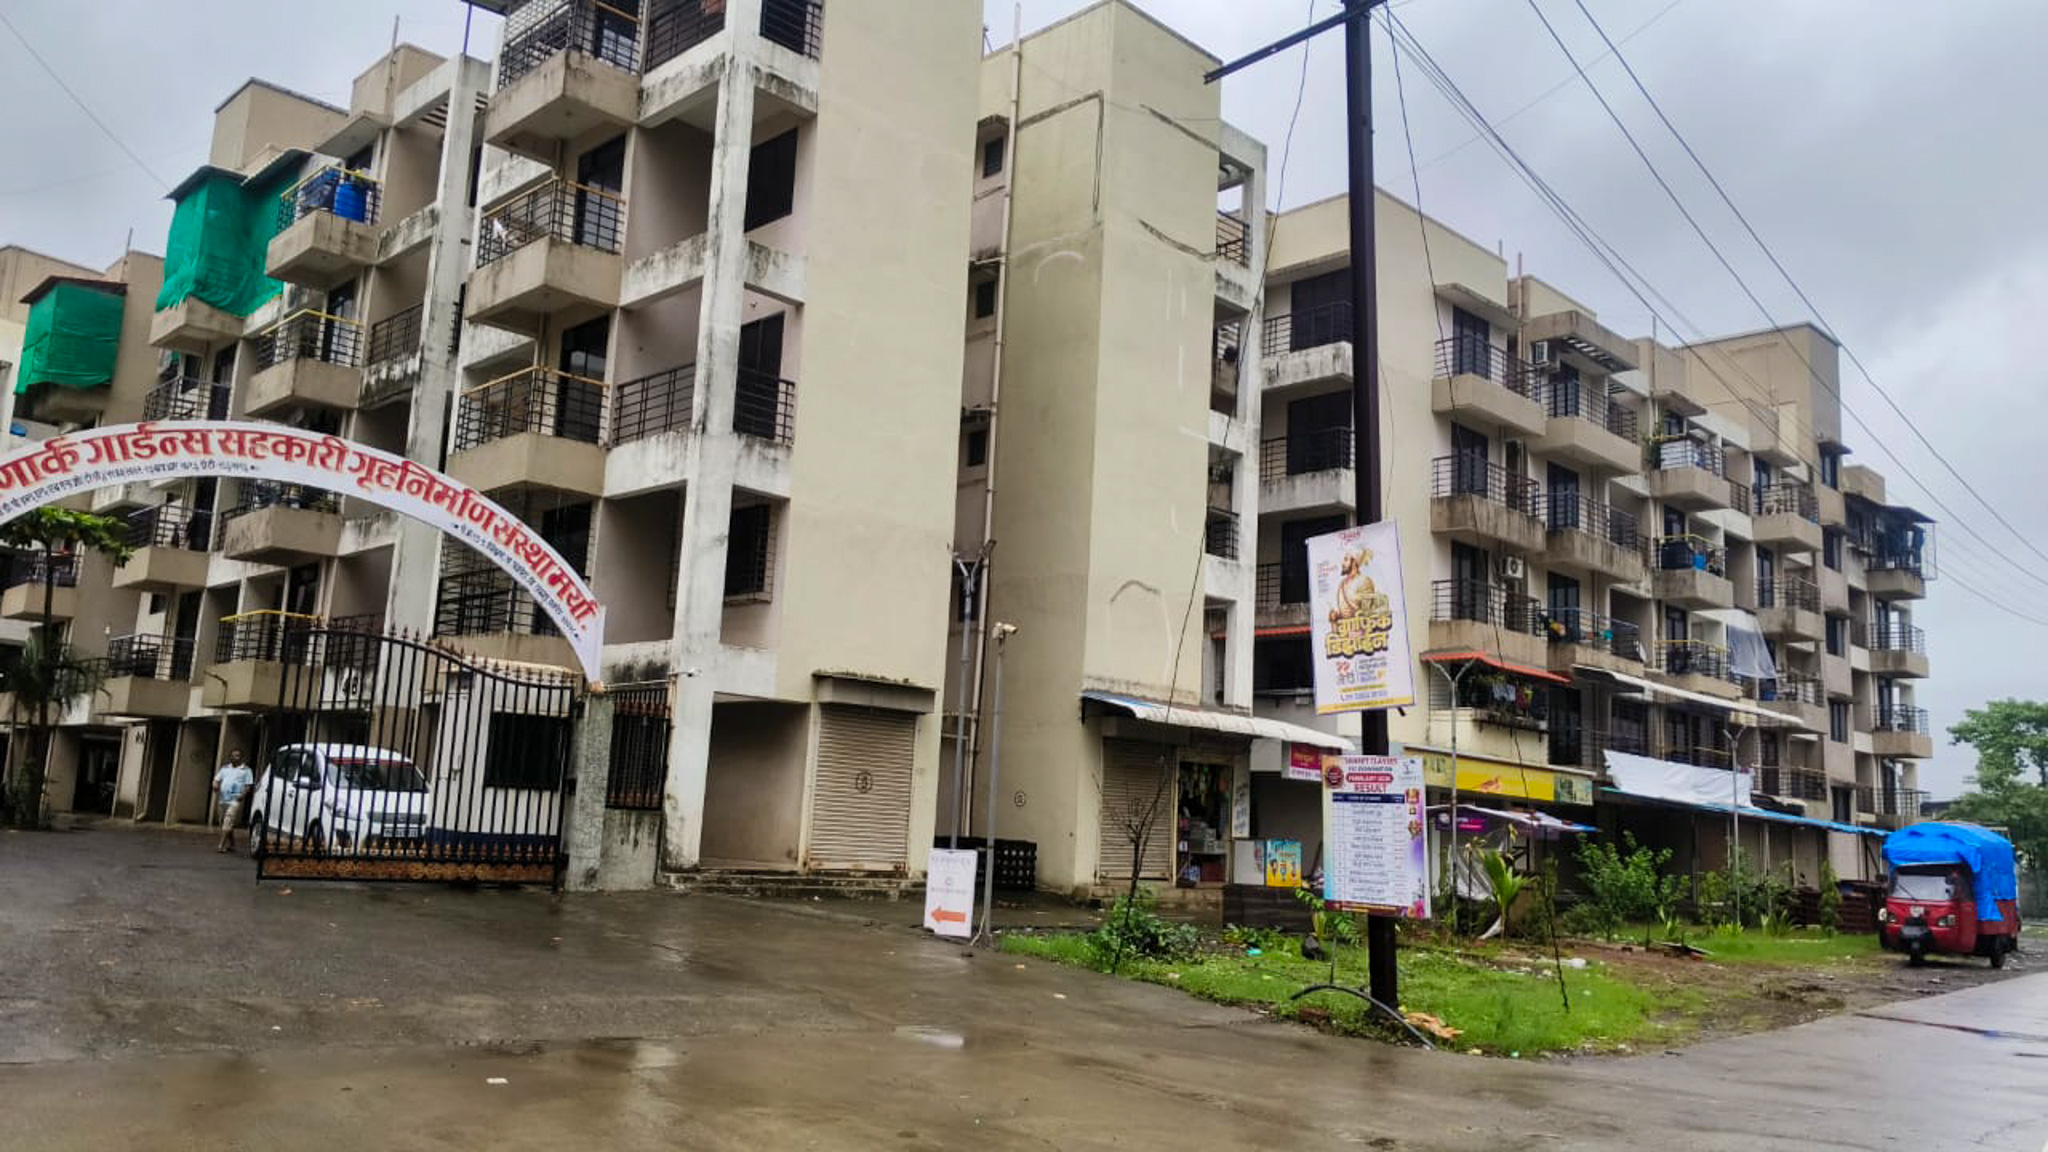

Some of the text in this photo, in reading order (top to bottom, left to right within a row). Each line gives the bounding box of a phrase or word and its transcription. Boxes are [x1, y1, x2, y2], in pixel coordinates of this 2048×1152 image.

[0, 436, 80, 490] णार्क
[82, 422, 213, 464] गार्डन्स
[217, 429, 348, 473] सहकारी
[1354, 783, 1387, 794] RESULT
